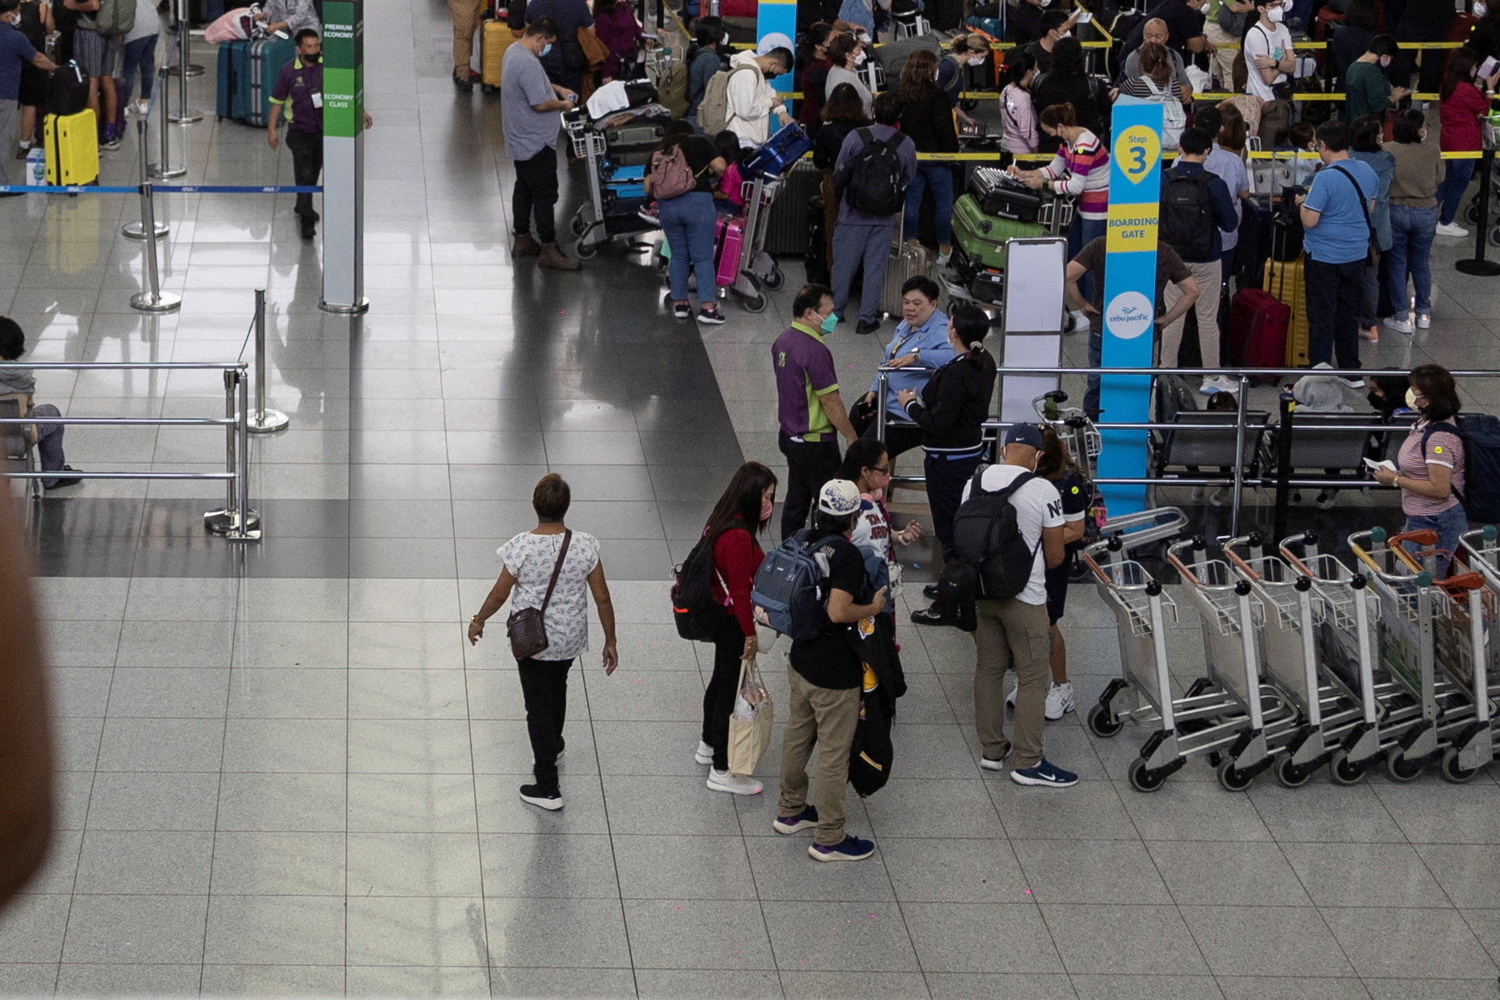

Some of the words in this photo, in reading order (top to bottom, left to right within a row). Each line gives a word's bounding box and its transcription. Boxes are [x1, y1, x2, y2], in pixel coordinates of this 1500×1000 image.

[324, 23, 353, 31] PREMIUM
[323, 31, 354, 39] ECONOMY
[323, 93, 354, 101] ECONOMY
[1128, 135, 1148, 144] Step
[1127, 146, 1147, 174] 3
[1108, 217, 1159, 227] BOARDING
[1121, 229, 1145, 239] GATE
[1109, 314, 1125, 323] cebu
[1126, 313, 1149, 323] pacific
[865, 513, 881, 526] TOM
[869, 525, 889, 541] JERRY
